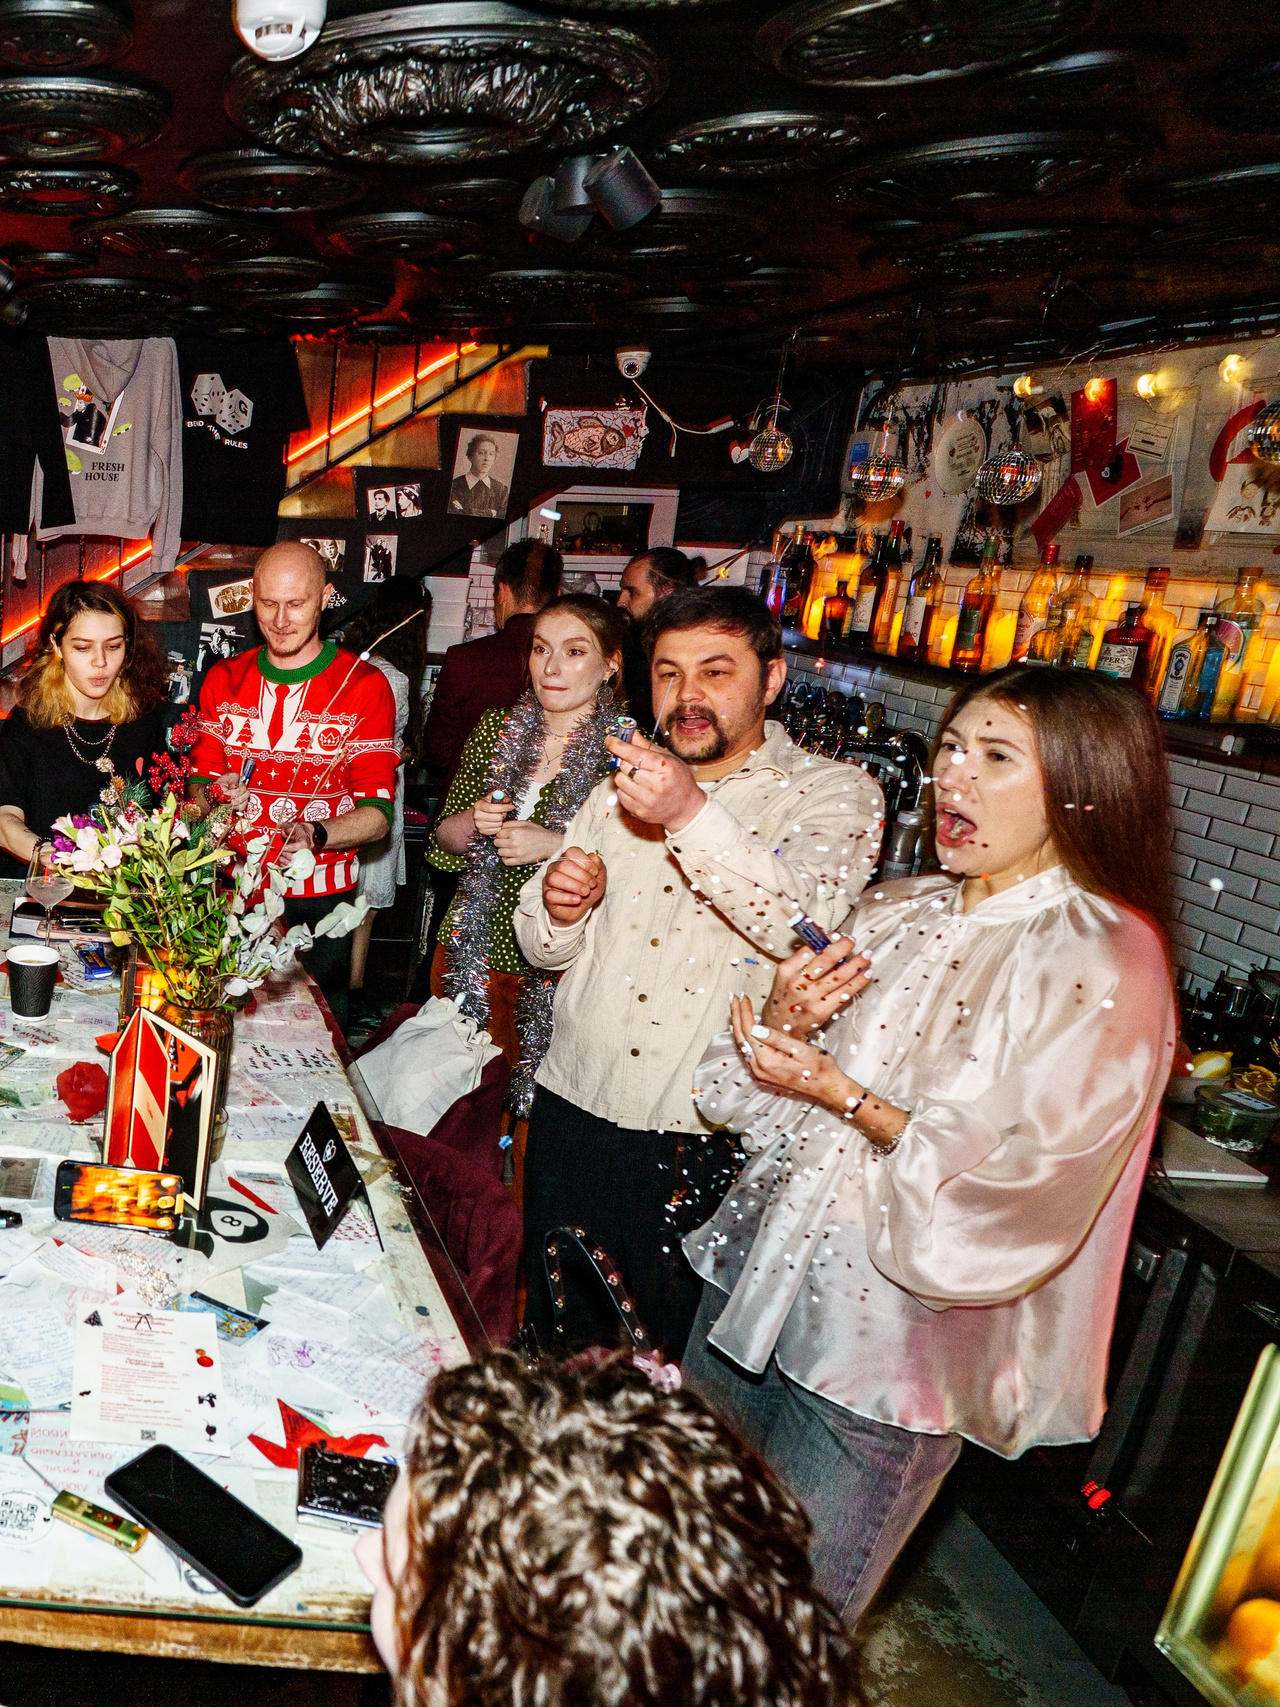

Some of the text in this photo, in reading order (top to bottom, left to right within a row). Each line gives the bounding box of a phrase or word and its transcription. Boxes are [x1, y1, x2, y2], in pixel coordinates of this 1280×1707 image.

[224, 439, 248, 449] RULES
[91, 462, 125, 472] FRESH
[85, 472, 120, 482] HOUSE
[299, 1132, 339, 1217] RESERVE
[221, 1215, 242, 1227] 8
